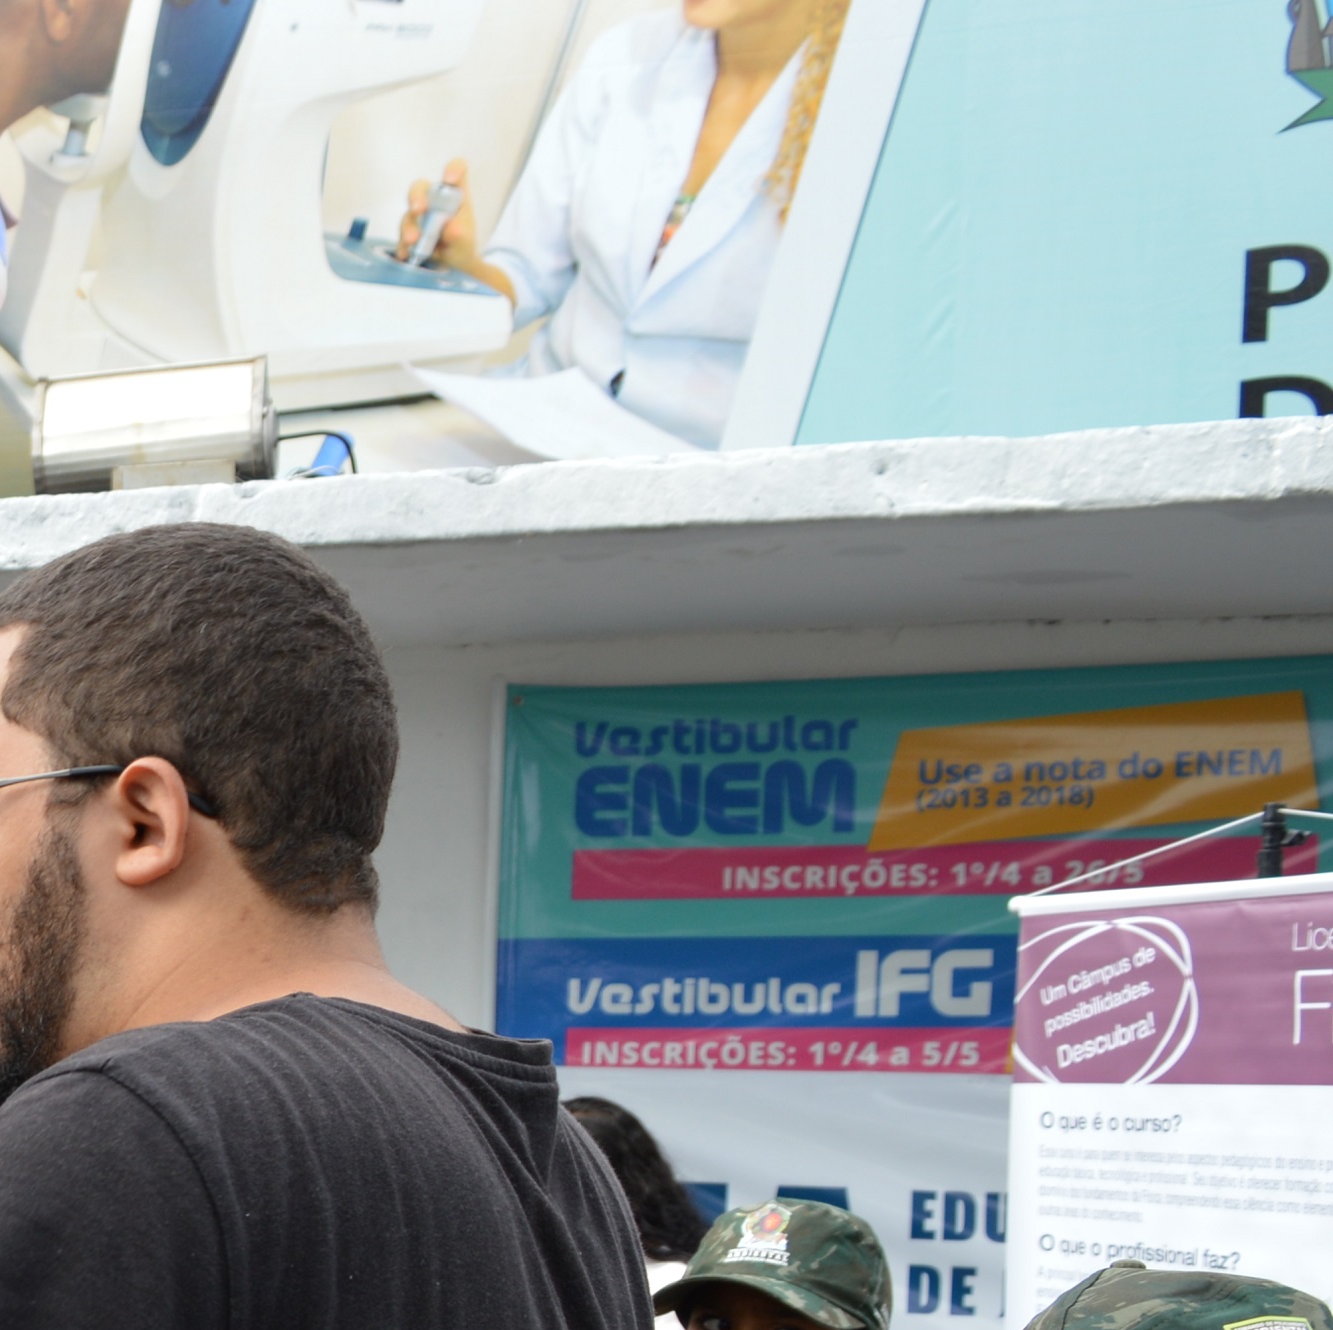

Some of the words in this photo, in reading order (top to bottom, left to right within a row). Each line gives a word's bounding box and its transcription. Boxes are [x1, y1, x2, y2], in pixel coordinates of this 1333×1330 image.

[575, 714, 859, 758] Vestibular
[918, 759, 983, 785] Use
[993, 763, 1013, 783] a
[1023, 759, 1108, 783] nota
[1118, 753, 1164, 780] do
[1175, 748, 1283, 778] ENEM
[574, 757, 858, 838] ENEM
[916, 786, 989, 812] (2013
[996, 791, 1011, 808] a
[1020, 784, 1095, 809] 2018)
[722, 860, 940, 896] INSCRIÇÕES:
[1034, 866, 1053, 886] a
[567, 976, 841, 1016] Vestibular
[854, 949, 994, 1019] IFG
[1039, 983, 1068, 1007] Um
[1067, 956, 1132, 997] Câmpus
[1132, 946, 1157, 968] de
[1044, 978, 1155, 1039] possibilidades.
[581, 1034, 798, 1074] INSCRIÇÕES:
[889, 1046, 910, 1066] a
[923, 1040, 981, 1067] 5/5
[1056, 1010, 1158, 1069] Descubra!
[1040, 1111, 1055, 1129] O
[1059, 1115, 1088, 1134] que
[1093, 1112, 1103, 1130] é
[1109, 1117, 1119, 1131] o
[1124, 1114, 1182, 1133] curso?
[1039, 1234, 1055, 1252] O
[1060, 1238, 1088, 1257] que
[1092, 1243, 1103, 1258] o
[1107, 1240, 1199, 1268] profissional
[1203, 1249, 1241, 1272] faz?
[907, 1264, 977, 1316] DE
